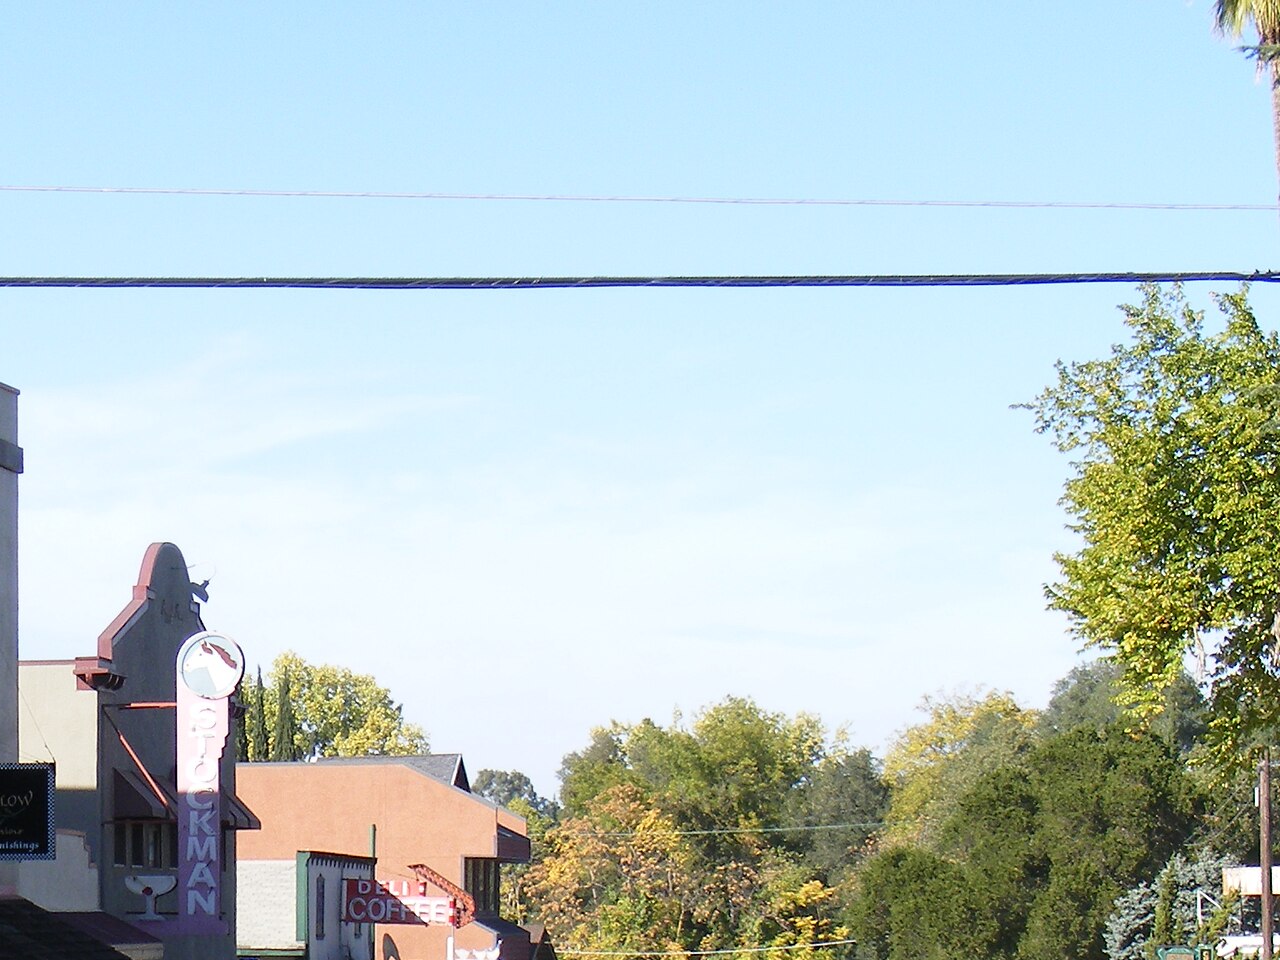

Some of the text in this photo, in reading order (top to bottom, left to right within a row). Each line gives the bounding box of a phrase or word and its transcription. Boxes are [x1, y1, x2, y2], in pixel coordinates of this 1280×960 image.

[186, 703, 218, 916] STOCKMAN
[357, 879, 411, 896] DELI
[348, 896, 449, 924] COFFEE
